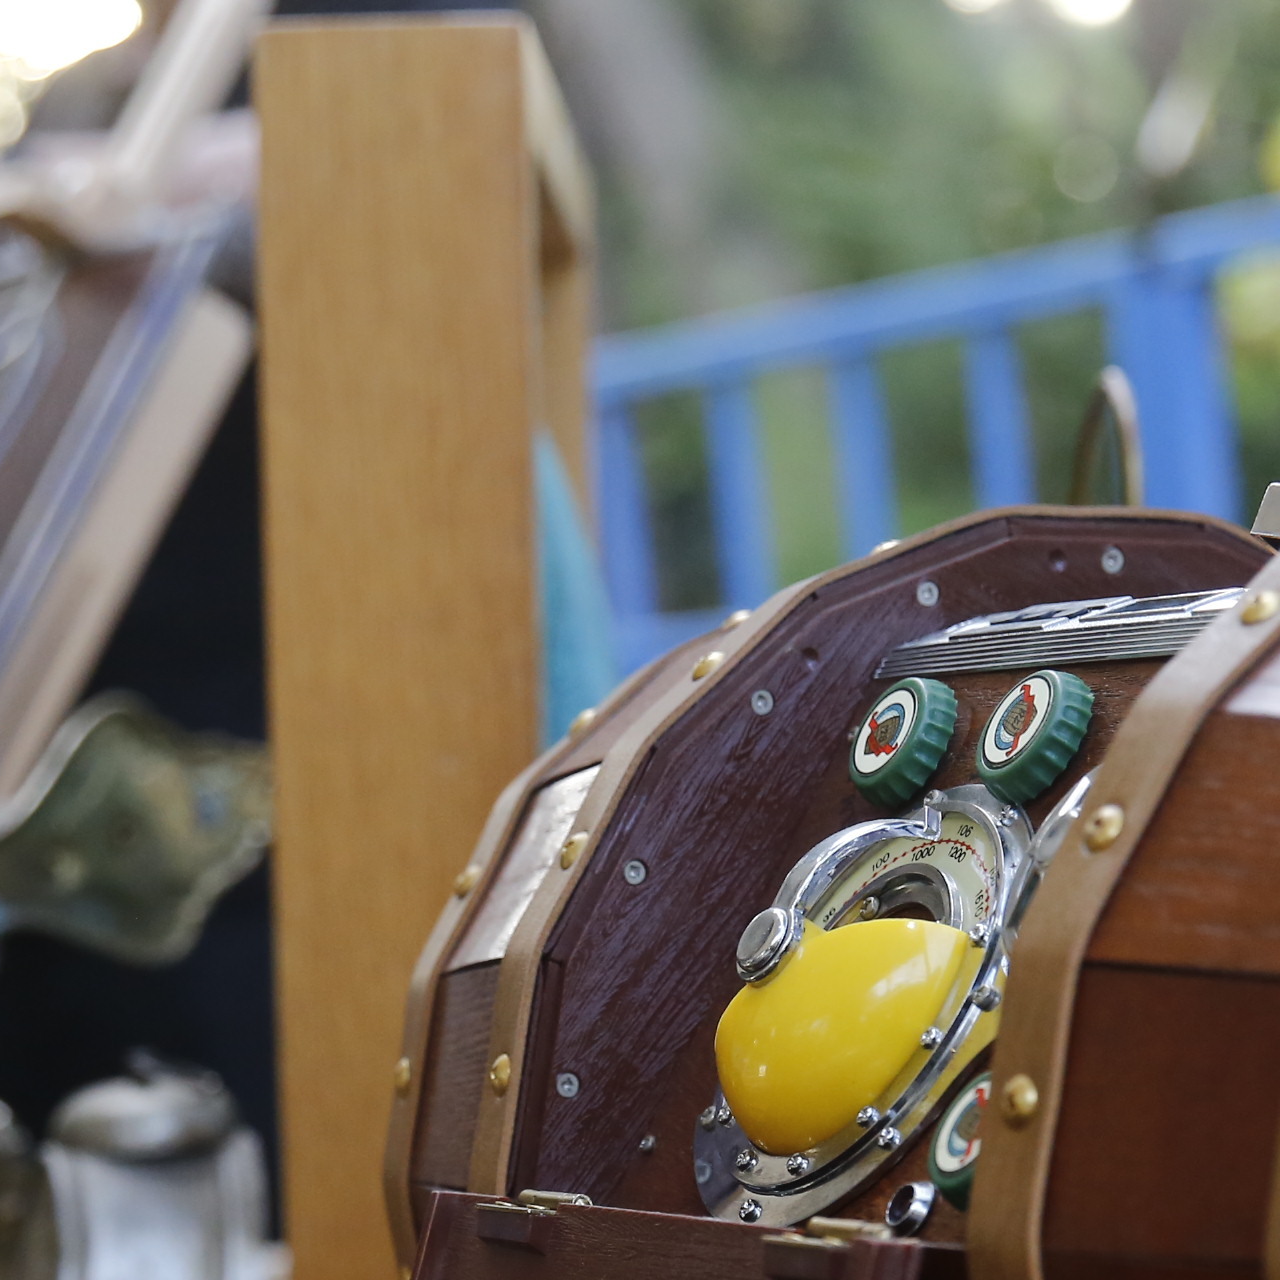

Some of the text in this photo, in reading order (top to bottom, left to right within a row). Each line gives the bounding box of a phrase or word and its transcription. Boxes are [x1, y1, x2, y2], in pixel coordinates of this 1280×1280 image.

[871, 852, 890, 872] 100
[911, 845, 936, 862] 1000
[948, 845, 967, 863] 1200
[974, 889, 984, 918] 1610
